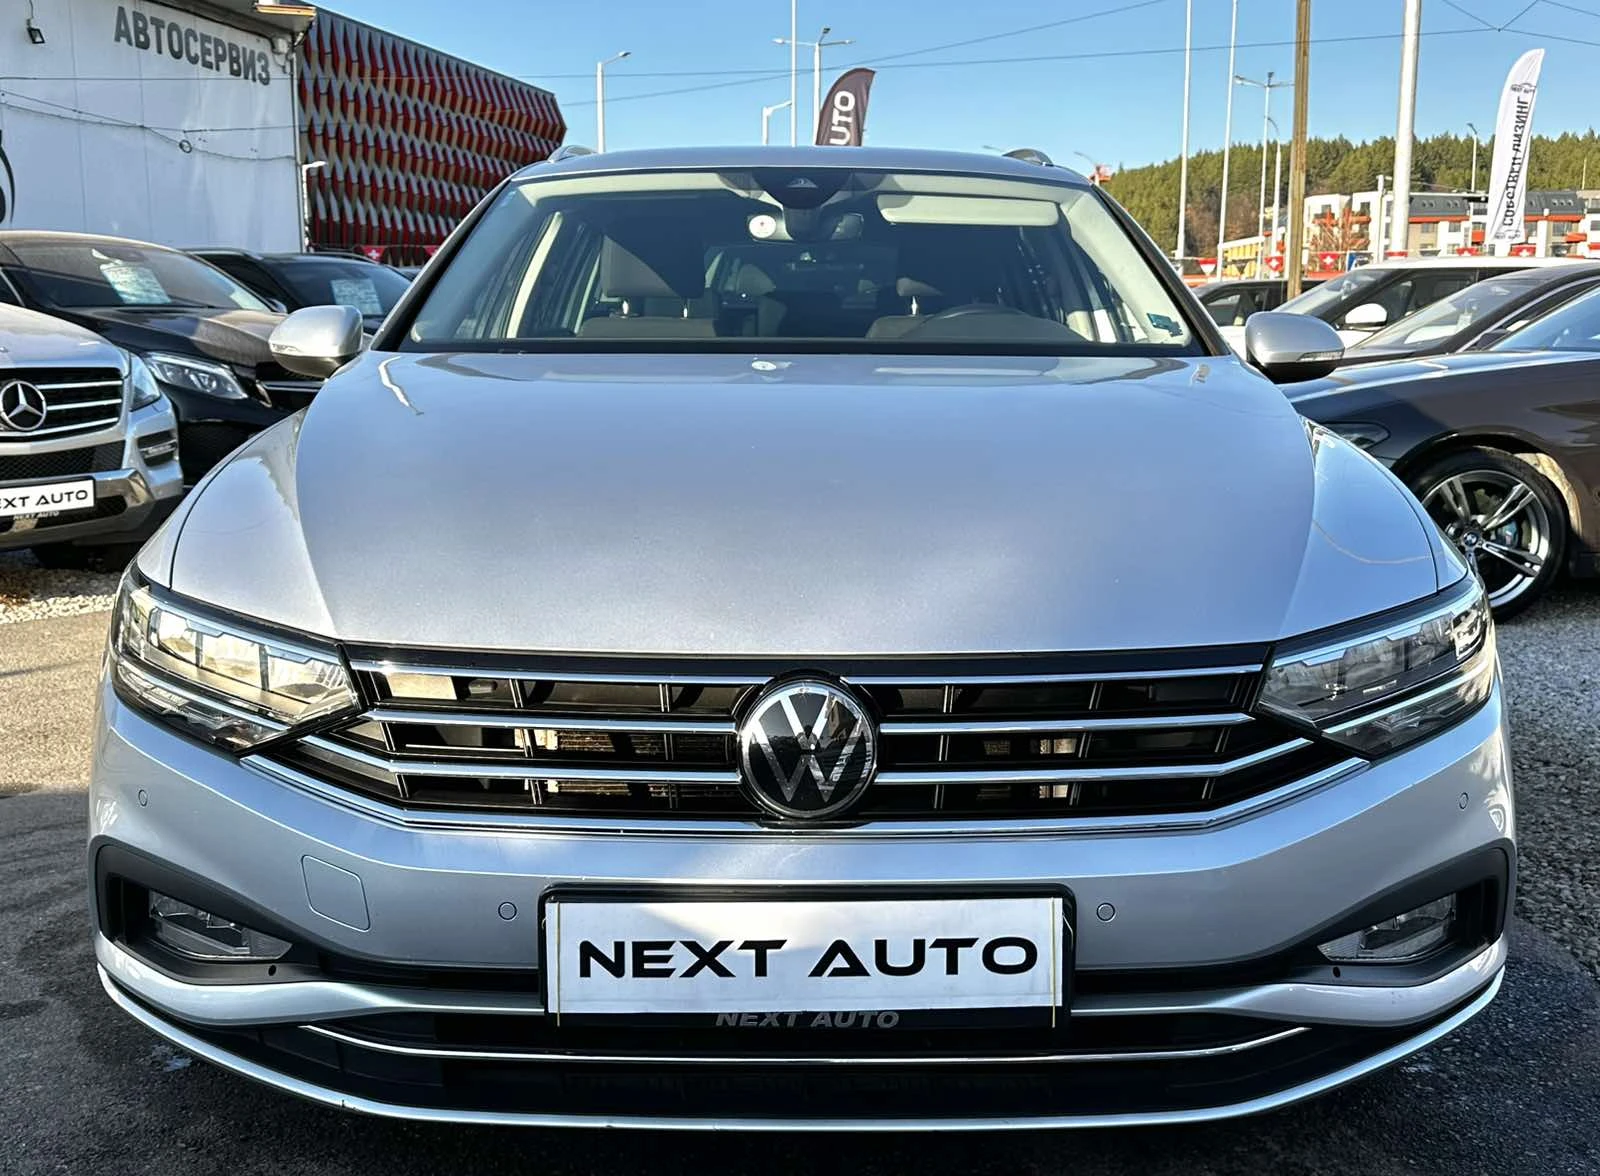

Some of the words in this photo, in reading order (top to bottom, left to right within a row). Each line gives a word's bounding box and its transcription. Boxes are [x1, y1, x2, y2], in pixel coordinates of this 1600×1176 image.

[114, 6, 270, 86] АВТОСЕРВИЗ
[0, 496, 30, 510] XT
[35, 489, 88, 506] AUTO
[579, 939, 788, 978] NEXT
[808, 936, 1039, 978] AUTO
[715, 1011, 803, 1028] NEXT
[810, 1011, 900, 1028] AUTO
